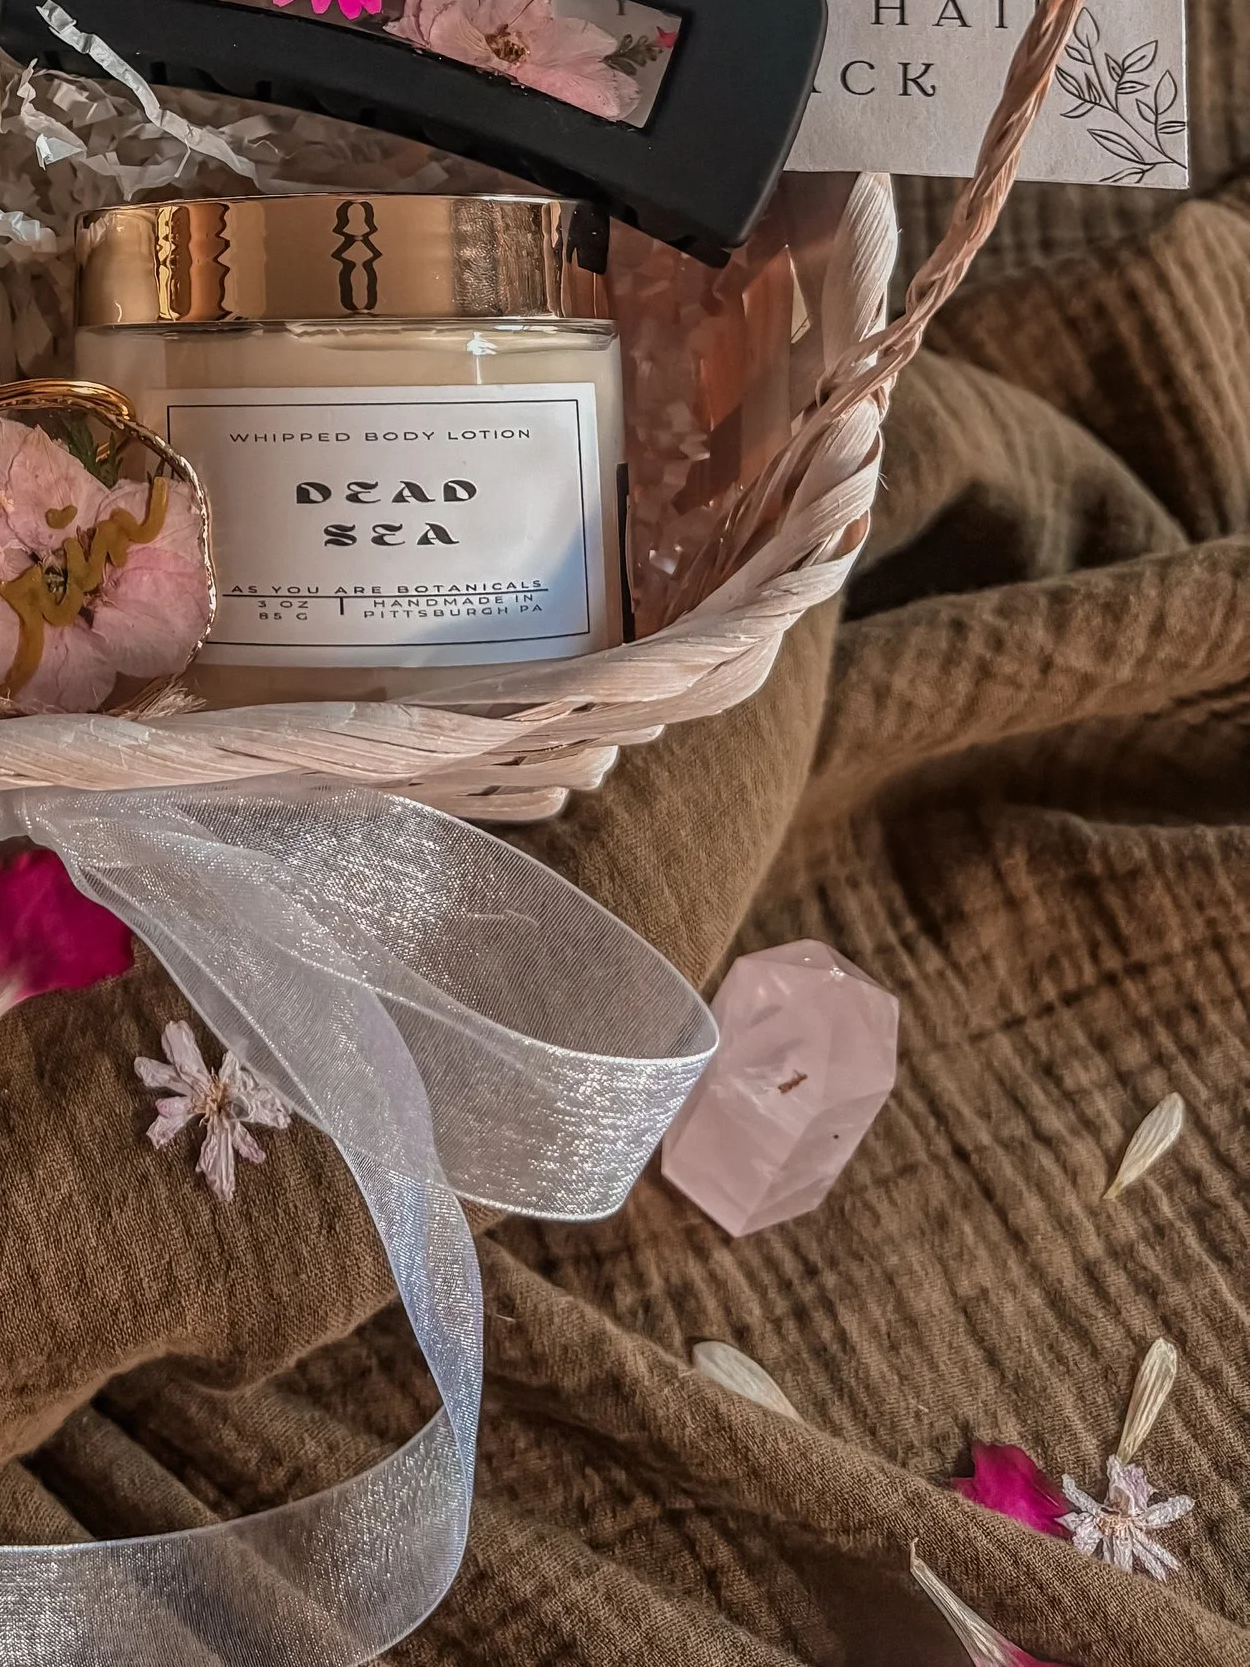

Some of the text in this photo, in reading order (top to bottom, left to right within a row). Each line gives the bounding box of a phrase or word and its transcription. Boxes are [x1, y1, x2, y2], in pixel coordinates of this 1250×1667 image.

[229, 428, 530, 443] WHIPPED BODY LOTION
[296, 480, 477, 504] DEAD
[324, 523, 460, 546] SEA
[230, 579, 542, 595] AS YOU ARE BOTANICALS
[257, 600, 309, 609] 3 OZ
[373, 593, 534, 608] HANDMADE IN
[258, 612, 308, 621] 85 G
[363, 604, 543, 619] PITTSBURGH PA
